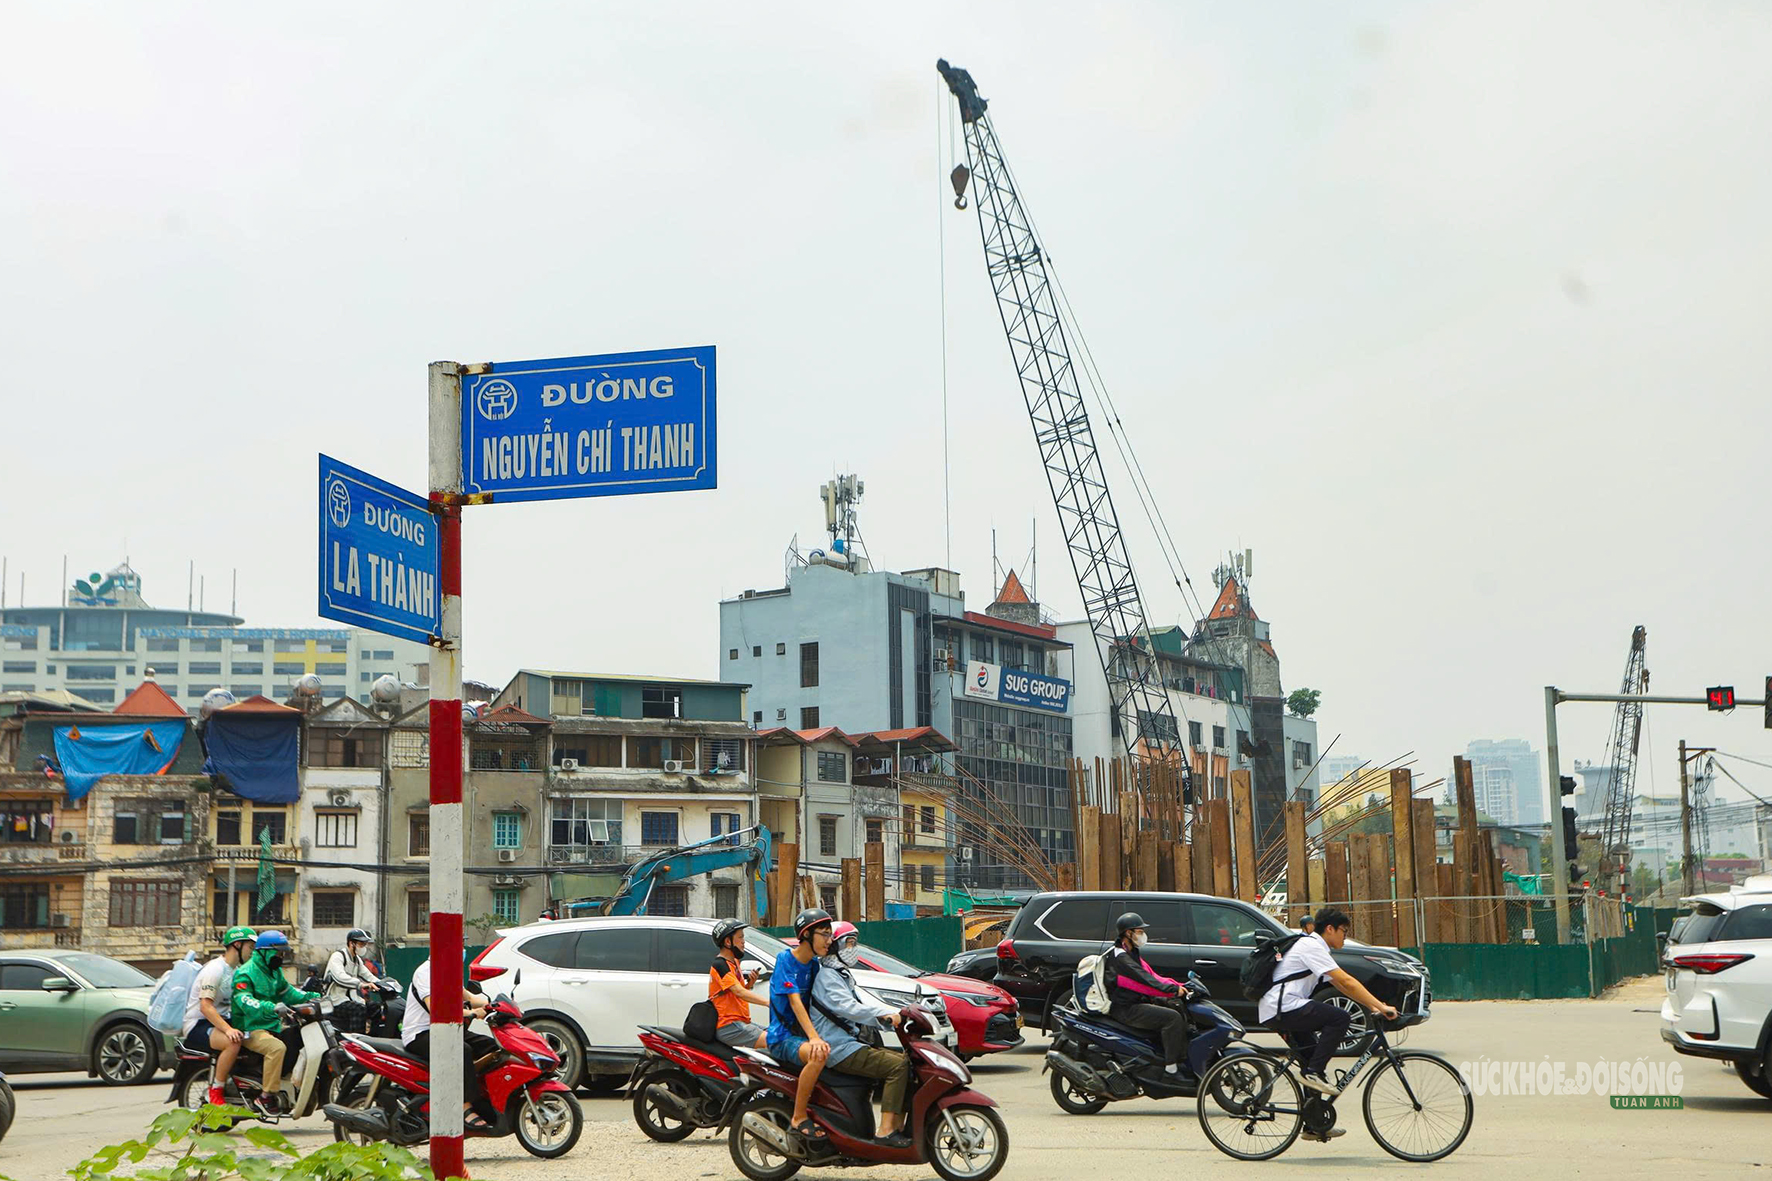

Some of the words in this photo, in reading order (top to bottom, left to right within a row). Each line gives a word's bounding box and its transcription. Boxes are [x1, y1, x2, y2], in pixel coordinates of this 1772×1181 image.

[541, 372, 674, 407] ĐƯỜNG
[483, 418, 568, 481] NGUYỄN
[577, 420, 612, 475] CHÍ
[621, 422, 694, 471] THANH
[364, 501, 425, 547] ĐƯỜNG
[333, 541, 361, 597] LA
[368, 552, 434, 619] THÀNH
[1005, 674, 1028, 694] SUG
[1030, 680, 1066, 700] GROUP
[1710, 691, 1733, 706] 41
